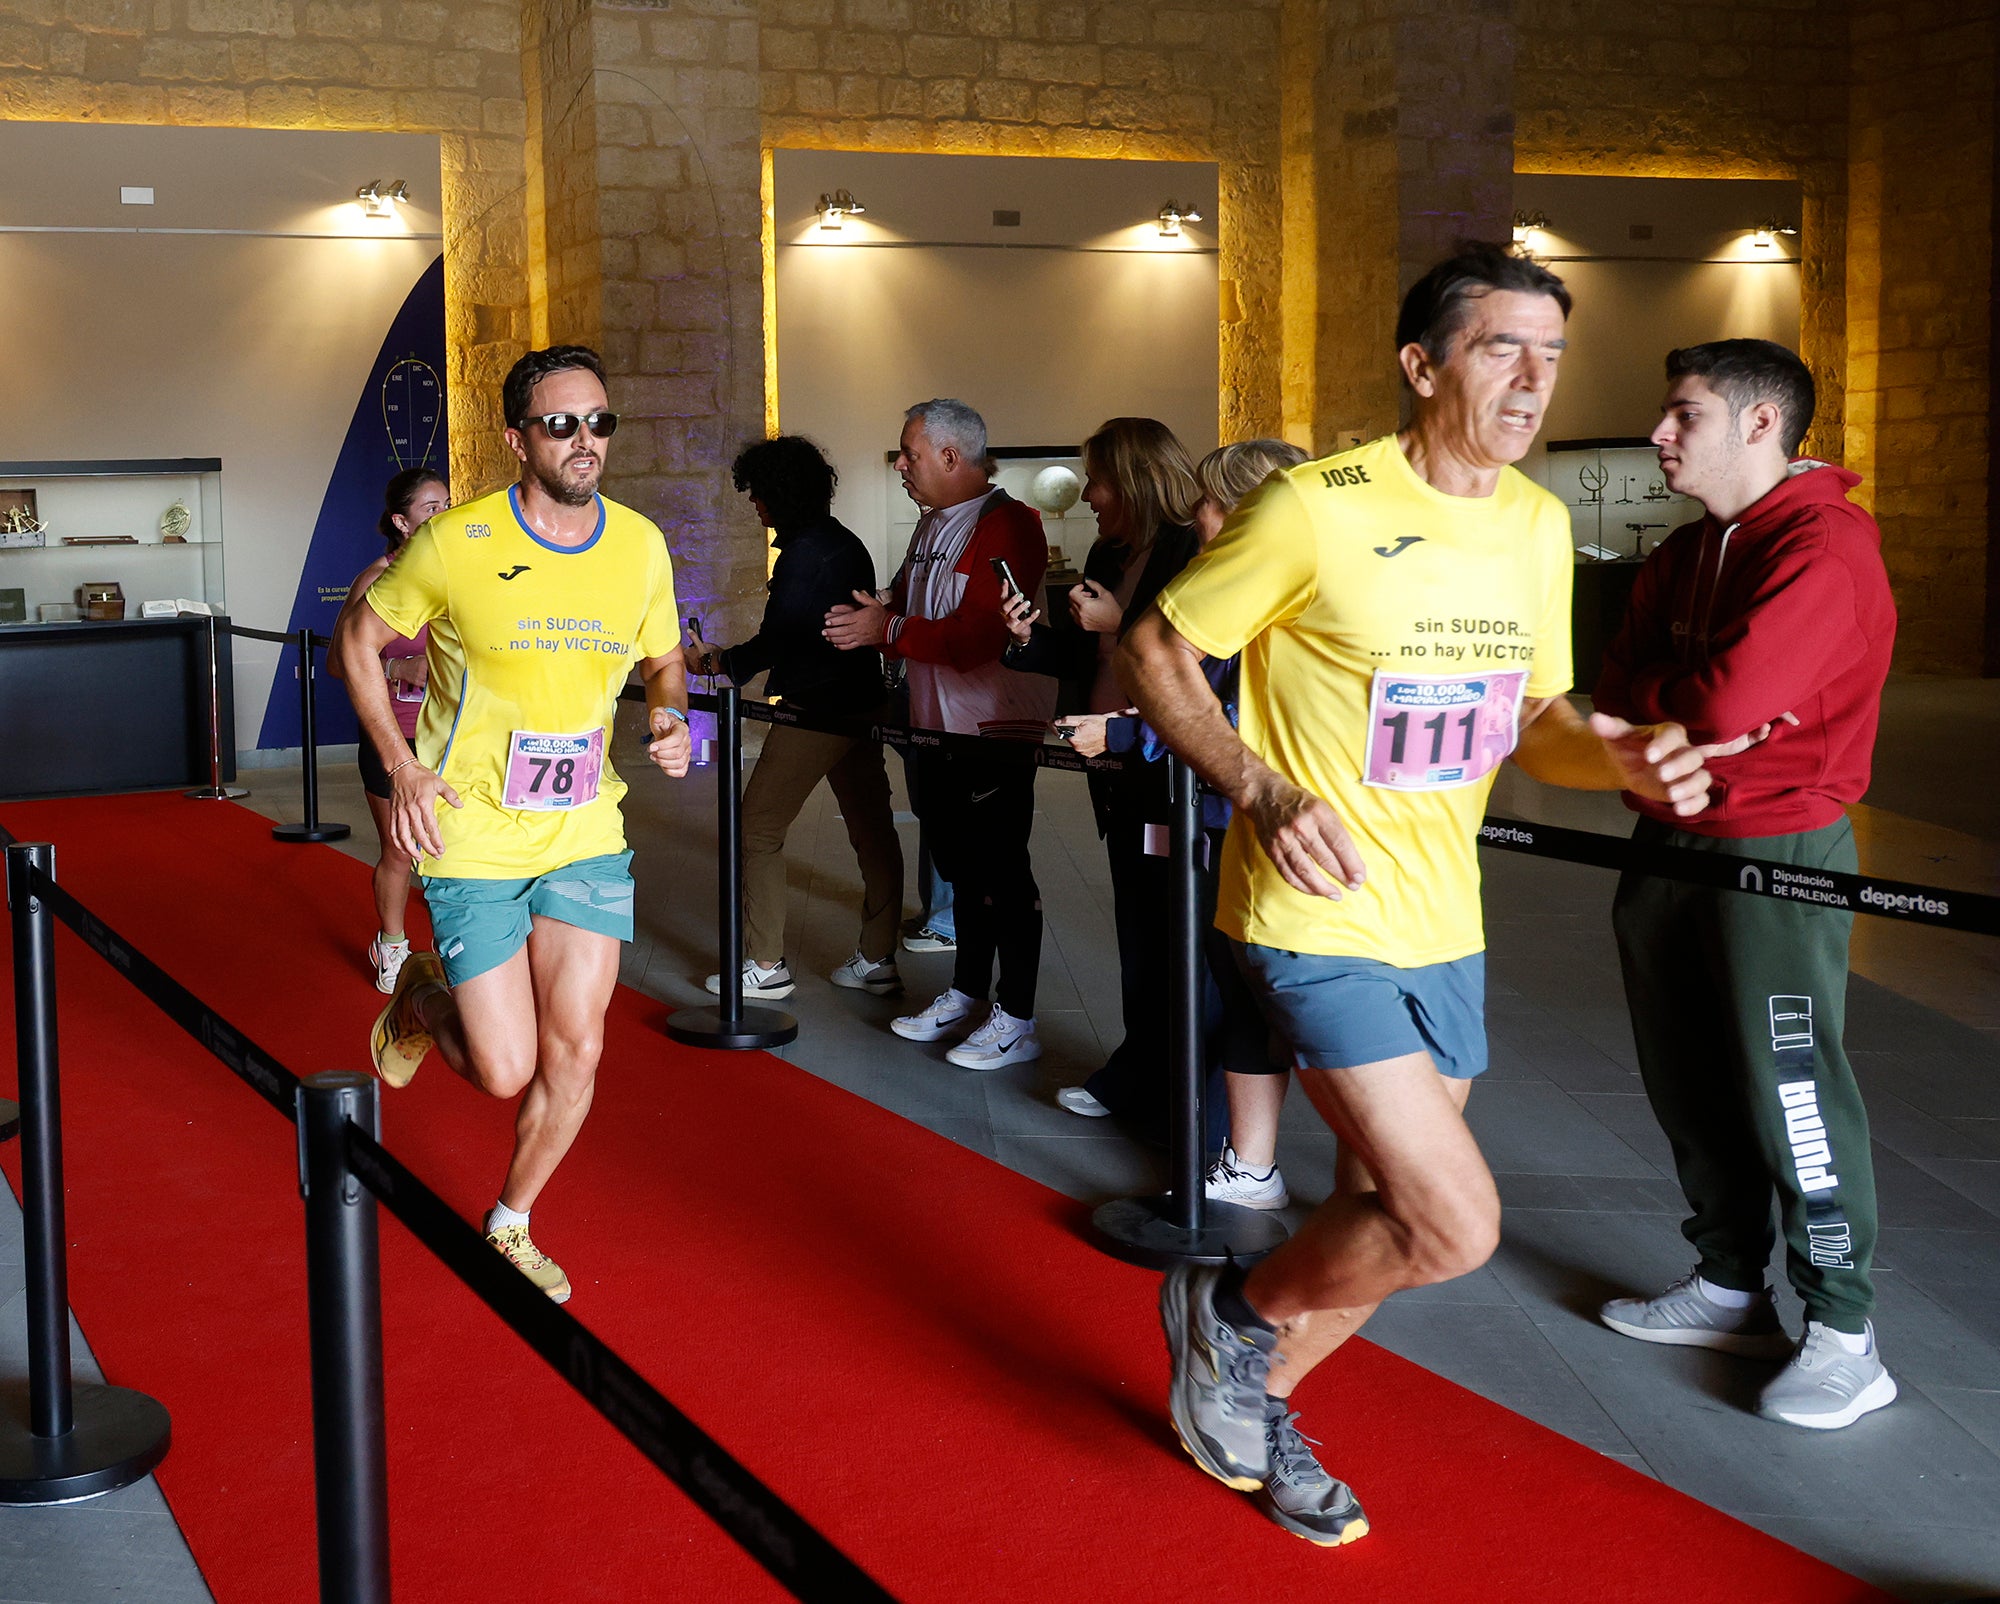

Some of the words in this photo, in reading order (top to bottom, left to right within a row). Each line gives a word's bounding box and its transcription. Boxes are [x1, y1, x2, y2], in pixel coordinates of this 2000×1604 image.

[388, 404, 399, 412] FEB
[1320, 465, 1372, 488] JOSE
[465, 523, 491, 538] GERO
[517, 617, 541, 630] sin
[546, 617, 615, 636] SUDOR...
[1415, 618, 1444, 633] sin
[1450, 618, 1531, 637] SUDOR...
[510, 640, 530, 650] no
[536, 637, 559, 653] hay
[1400, 645, 1427, 657] no
[1435, 642, 1466, 661] hay
[1416, 684, 1466, 697] 10.000
[539, 739, 574, 748] 10.000
[1383, 708, 1477, 765] 111
[528, 757, 575, 795] 78
[1772, 869, 1834, 889] Diputación
[1772, 884, 1789, 897] DE
[1791, 886, 1849, 907] PALENCIA
[1859, 886, 1949, 916] deportes
[1778, 1080, 1839, 1194] PUMA
